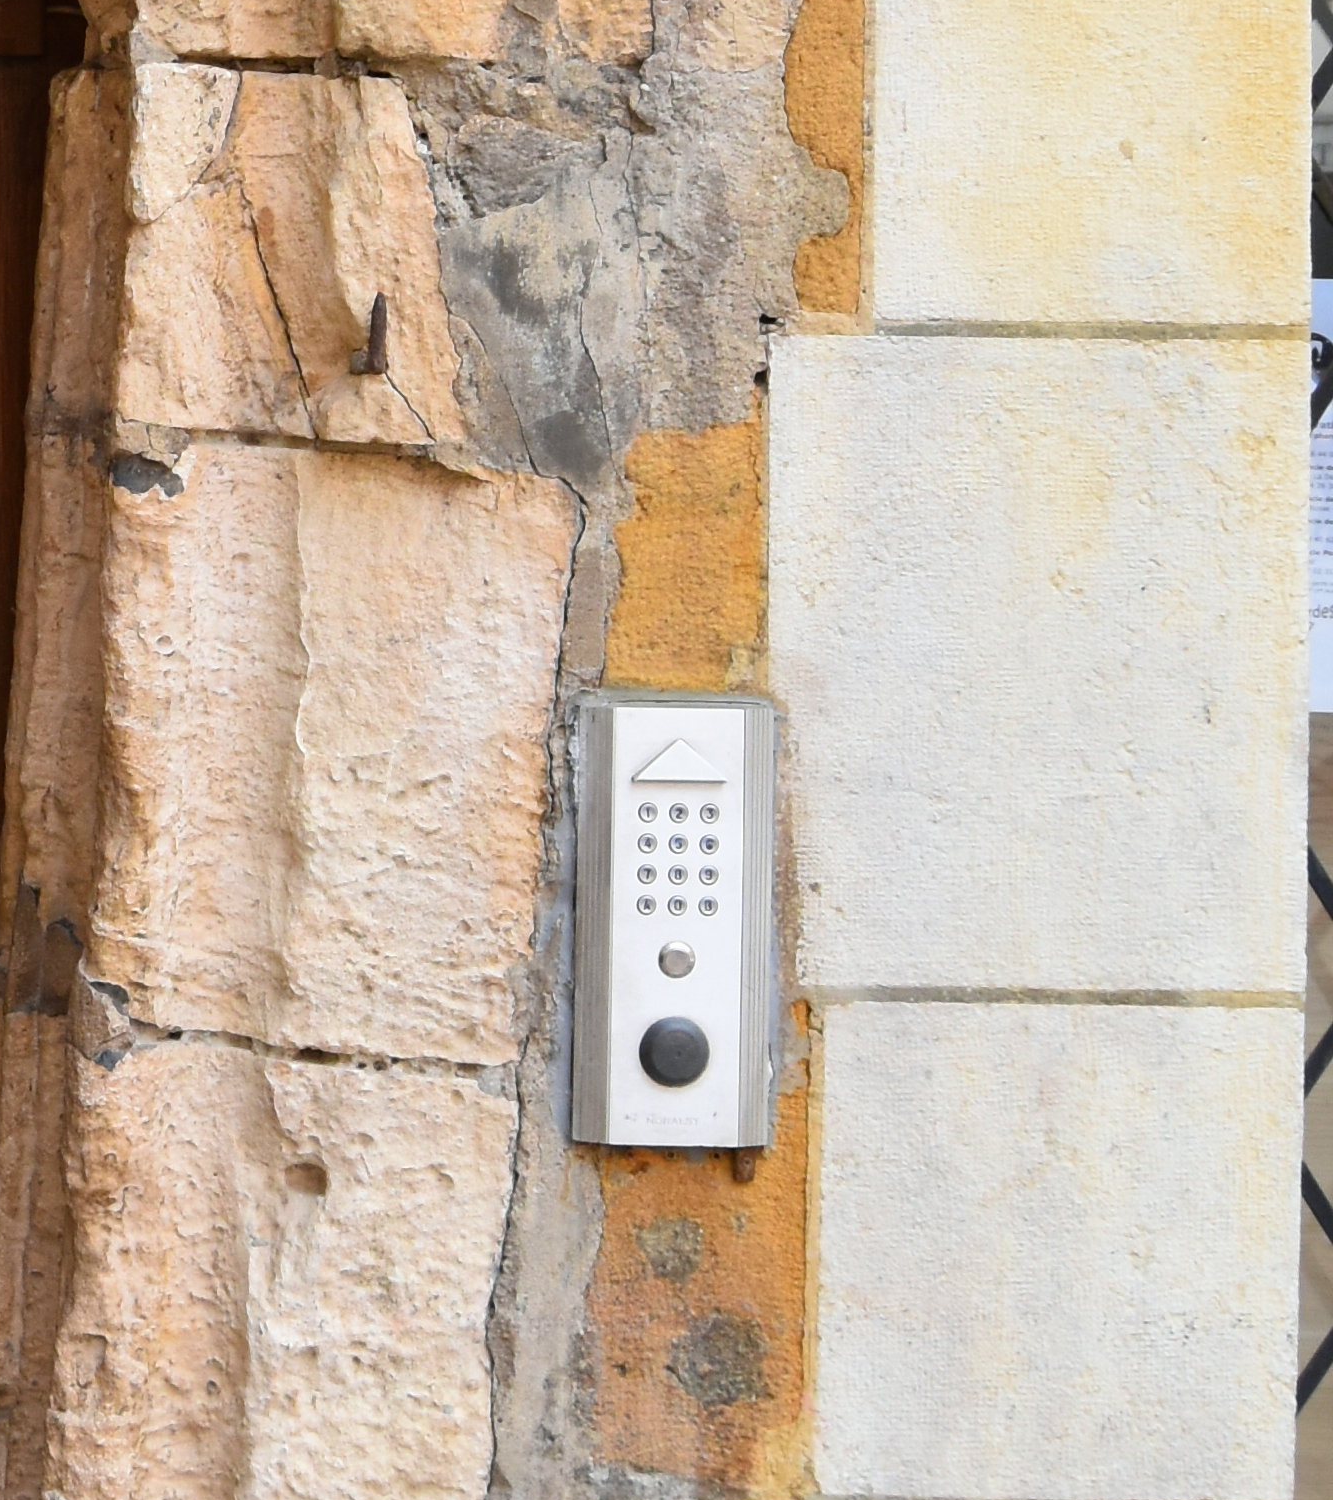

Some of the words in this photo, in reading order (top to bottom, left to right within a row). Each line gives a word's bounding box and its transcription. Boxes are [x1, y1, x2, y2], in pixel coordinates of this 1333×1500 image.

[674, 807, 683, 819] 2
[706, 807, 715, 820] 3
[674, 837, 683, 849] 5
[705, 838, 715, 850] 6
[643, 868, 652, 880] 7
[674, 868, 683, 880] 8
[705, 868, 713, 880] 9
[643, 898, 652, 910] A
[673, 899, 683, 911] 0
[704, 899, 714, 911] B
